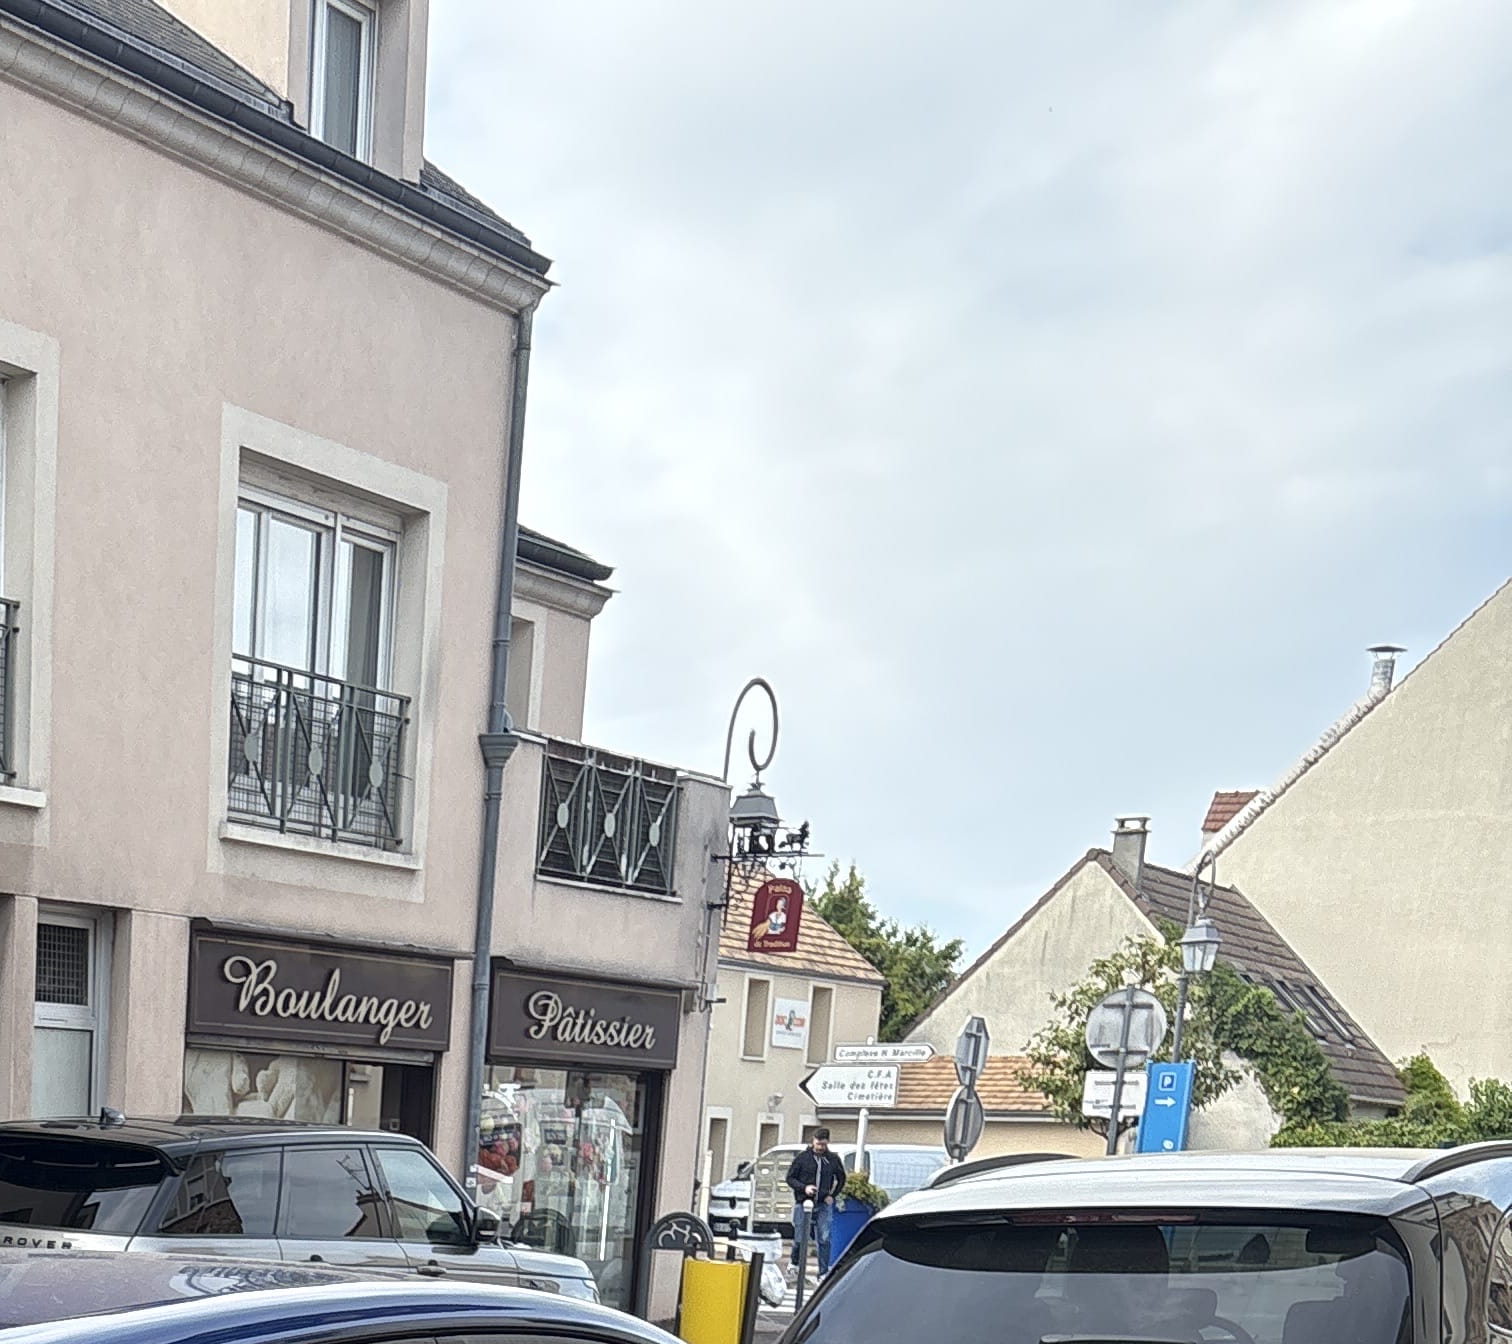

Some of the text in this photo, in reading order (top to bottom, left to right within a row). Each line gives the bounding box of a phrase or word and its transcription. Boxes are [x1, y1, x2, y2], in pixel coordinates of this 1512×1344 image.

[223, 955, 433, 1046] Boulanger
[528, 990, 656, 1050] Pâtissier
[821, 1080, 894, 1090] Salle des fêtes
[847, 1091, 893, 1101] Cimetière
[3, 1235, 73, 1250] ROVER
